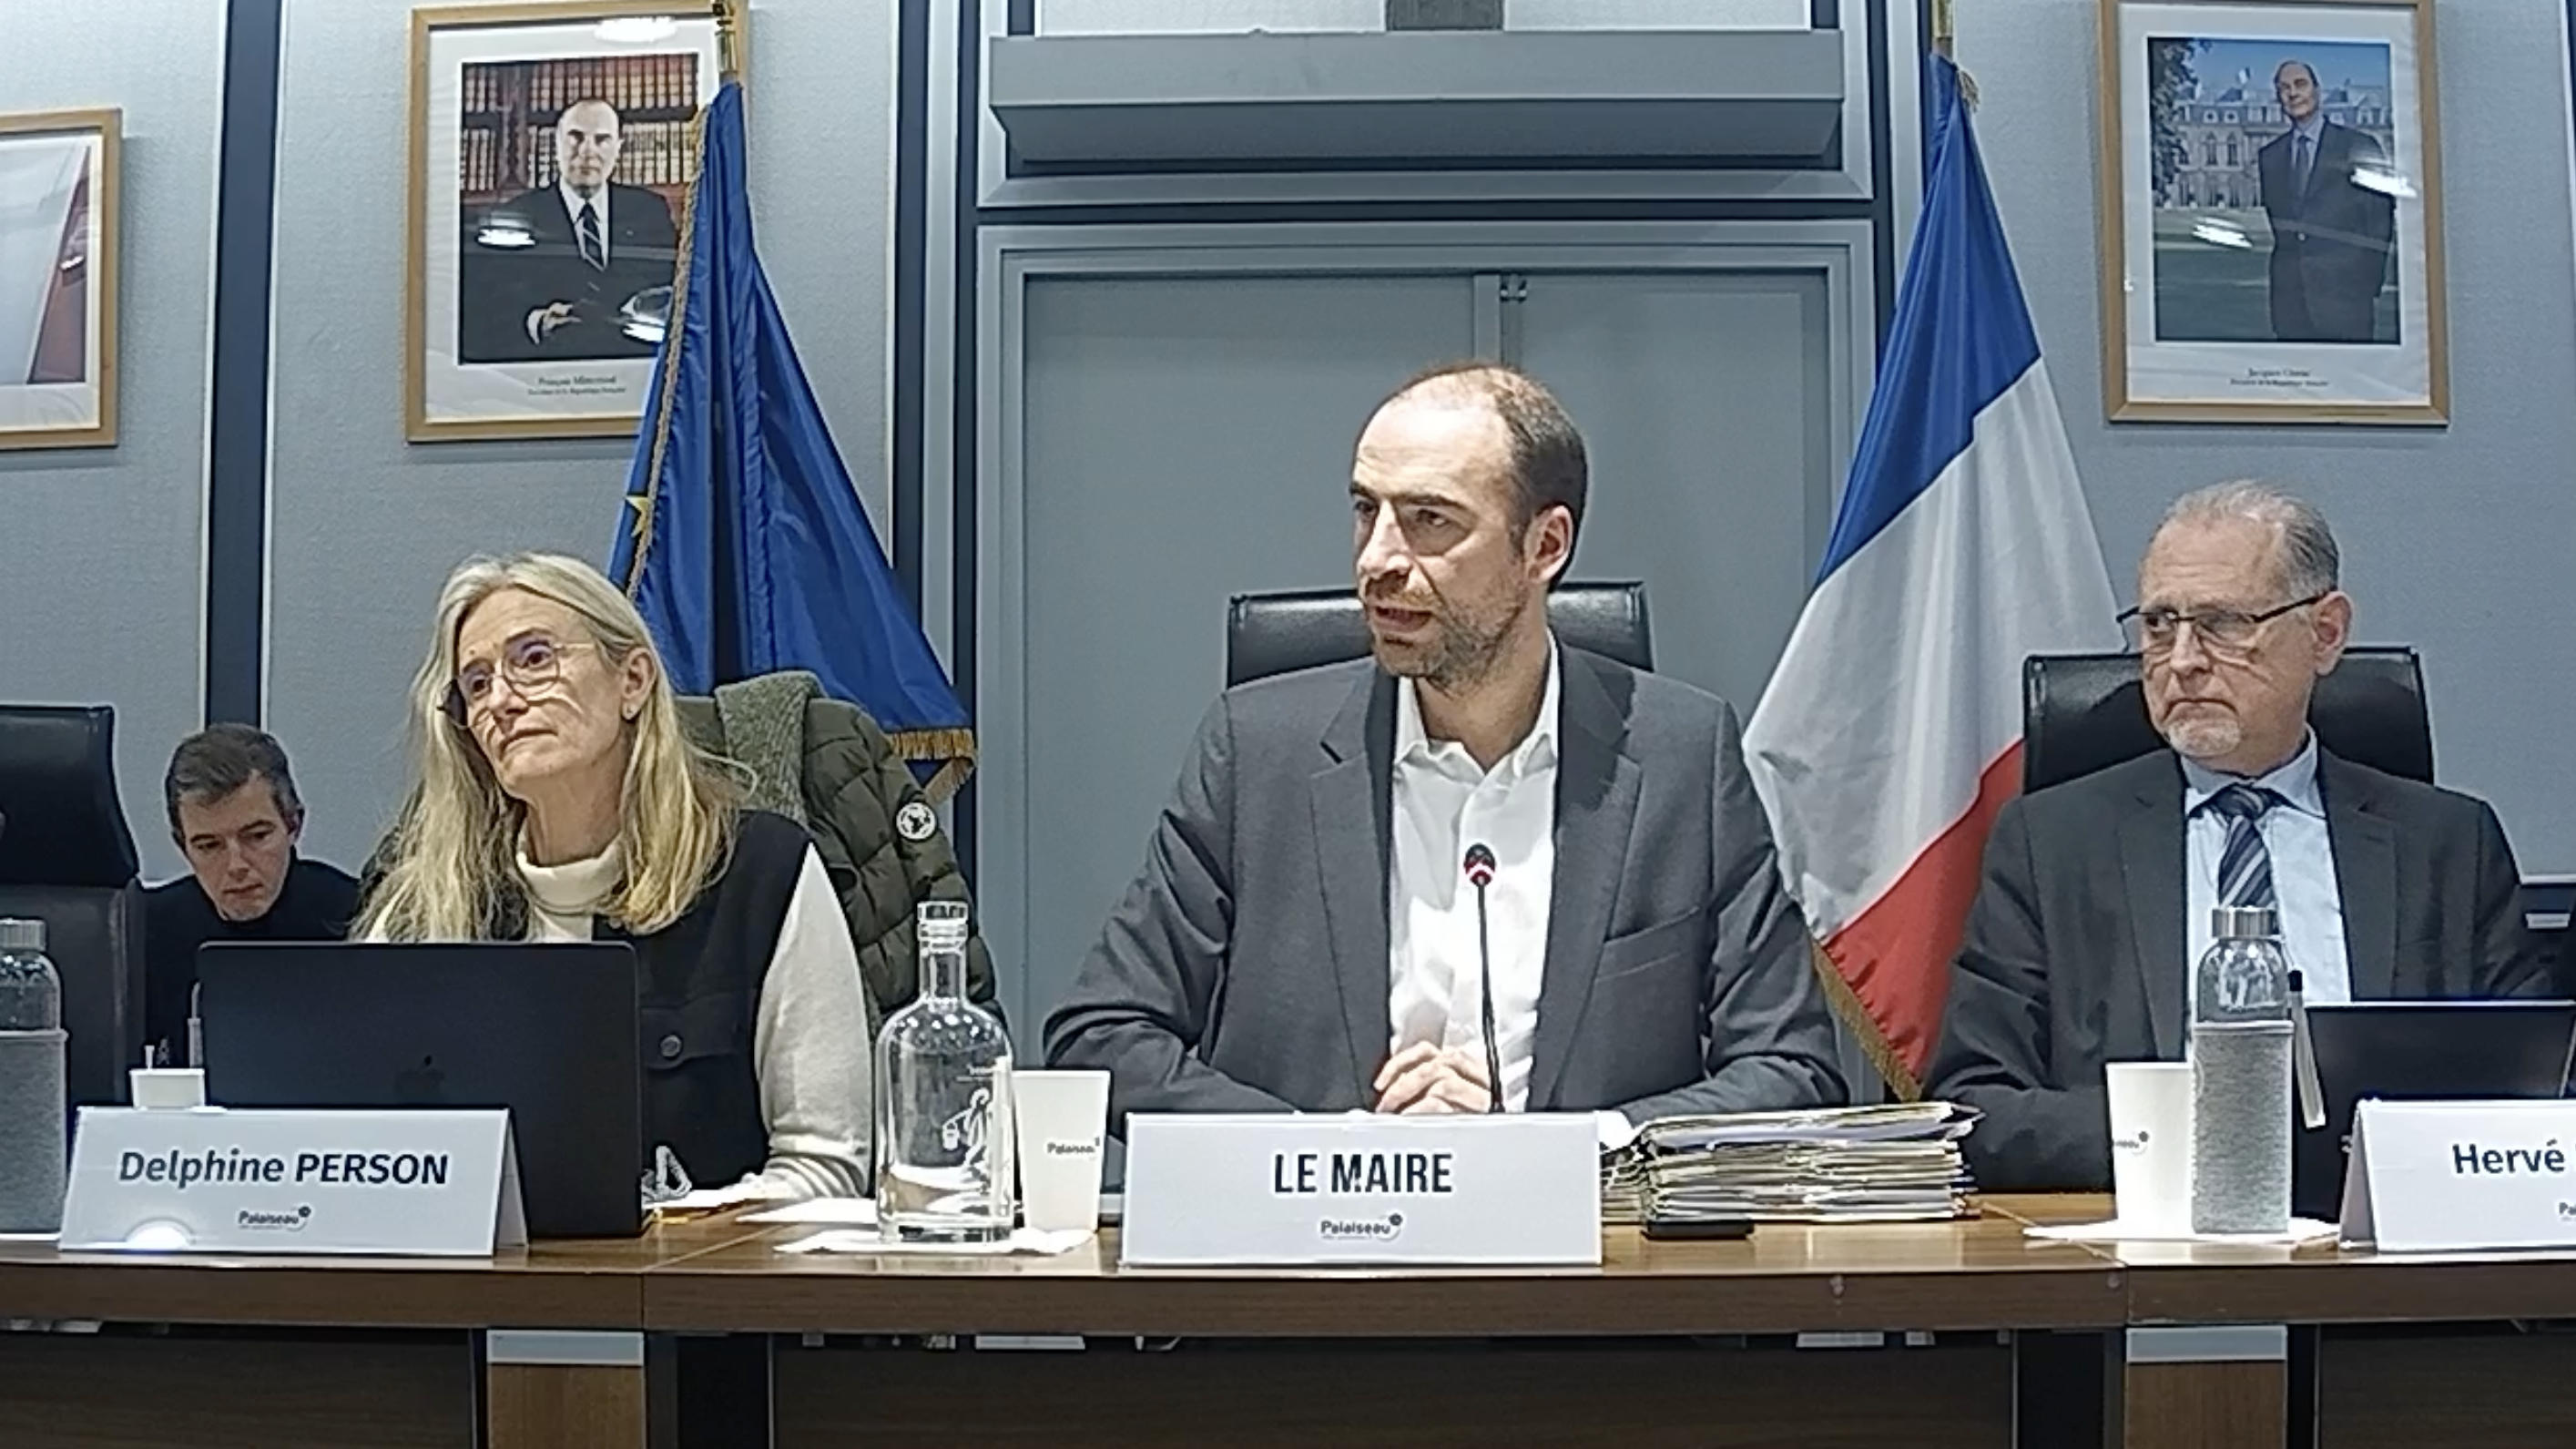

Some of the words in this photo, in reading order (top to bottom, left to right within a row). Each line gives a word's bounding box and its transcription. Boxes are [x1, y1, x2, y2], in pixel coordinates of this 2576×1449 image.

[119, 1148, 284, 1189] Delphine
[295, 1153, 448, 1184] PERSON
[1275, 1154, 1318, 1193] LE
[1331, 1154, 1452, 1193] MAIRE
[2452, 1138, 2565, 1174] Hervé
[238, 1209, 299, 1224] Palaiseau
[1320, 1220, 1390, 1234] Palaiseau
